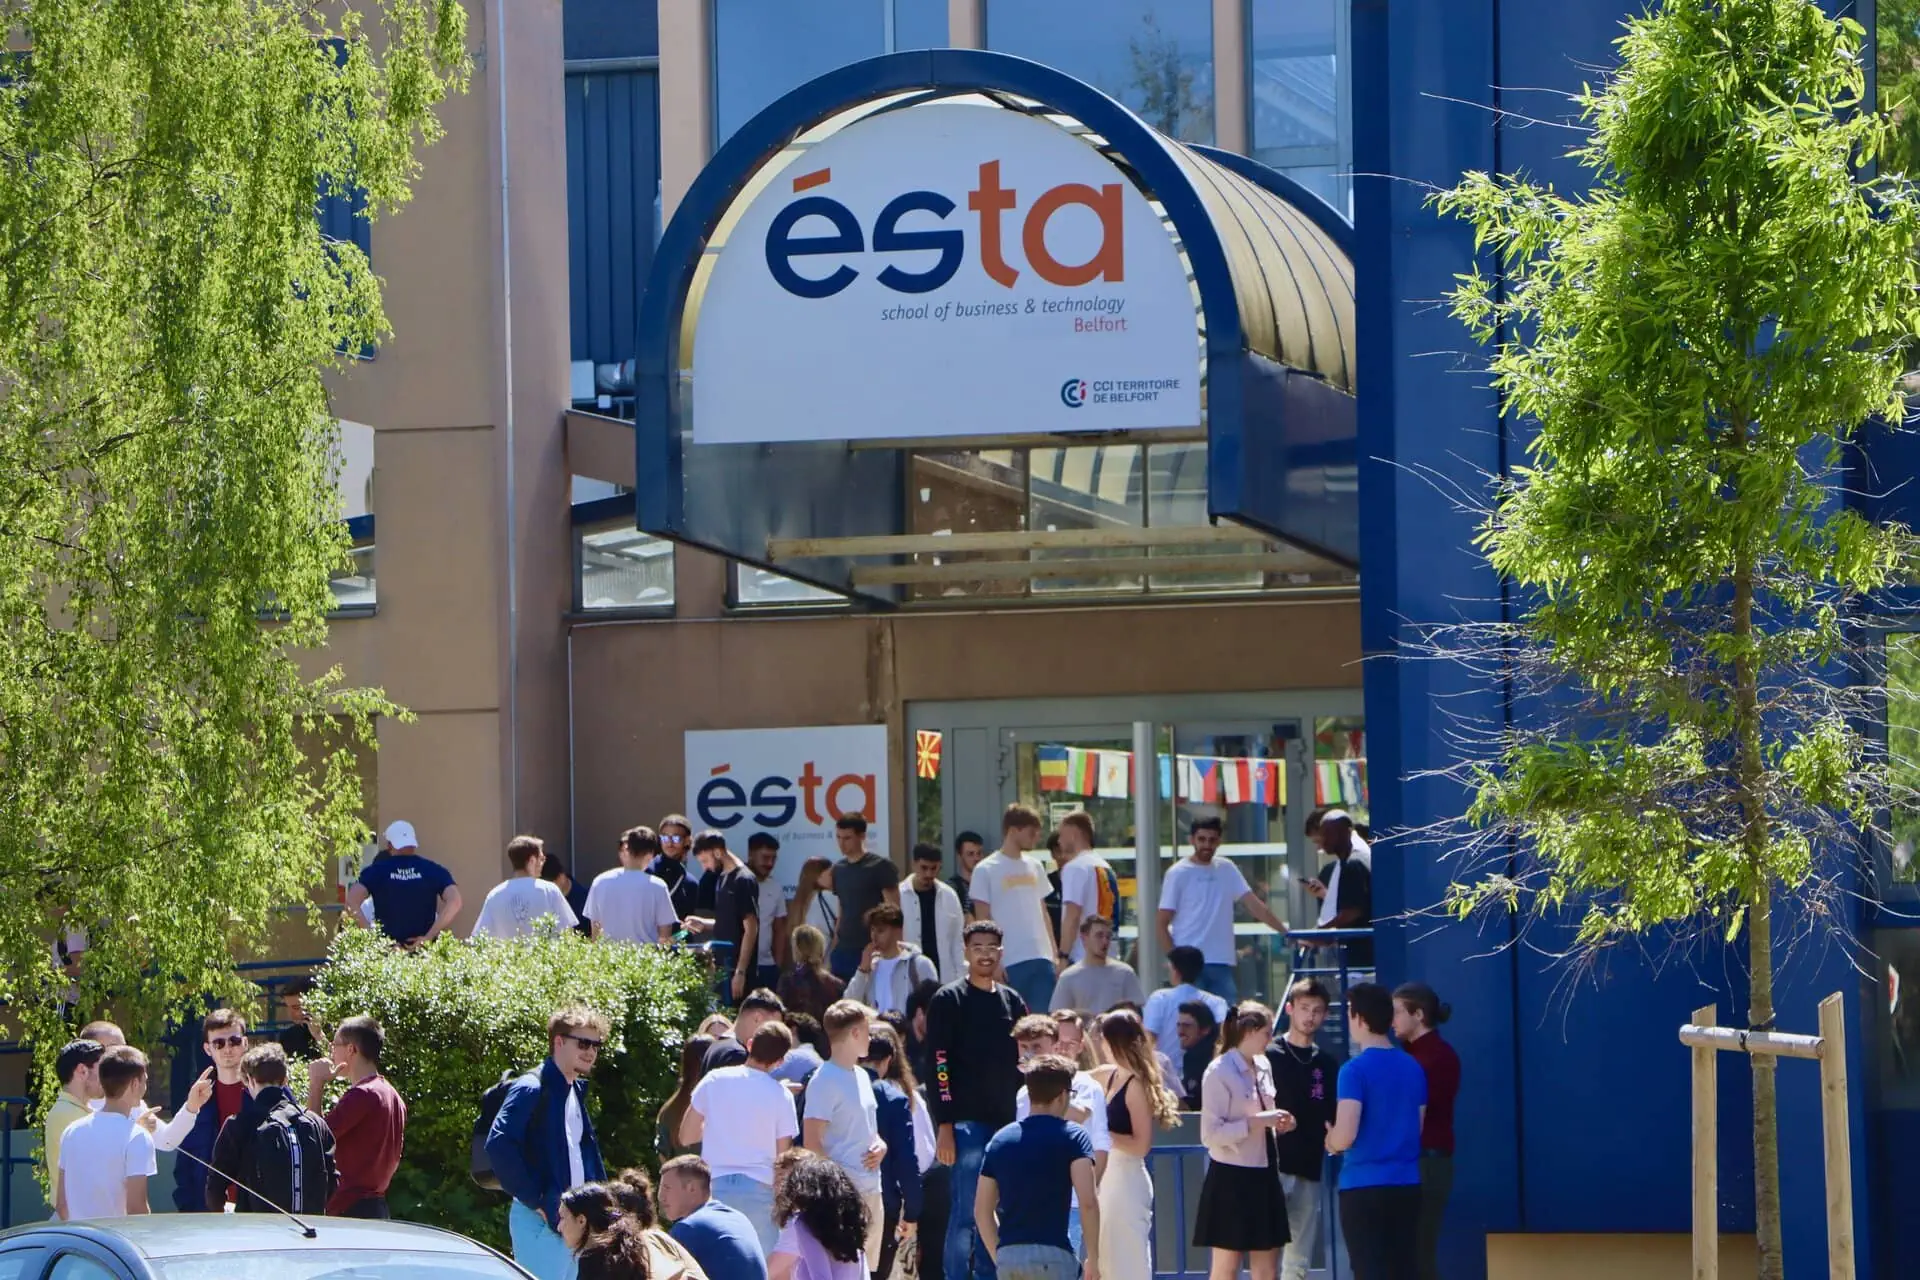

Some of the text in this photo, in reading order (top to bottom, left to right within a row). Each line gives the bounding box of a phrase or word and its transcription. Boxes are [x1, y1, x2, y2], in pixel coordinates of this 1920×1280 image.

[765, 160, 1124, 299] ésta
[881, 295, 1125, 321] school of business & technology
[1074, 316, 1128, 333] Belfort
[1093, 379, 1181, 392] CCI TERRITOIRE
[1093, 391, 1160, 403] DE BELFORT
[697, 760, 876, 829] ésta
[390, 872, 422, 880] RWANDA
[397, 867, 416, 875] VISIT
[936, 1050, 952, 1101] LACOSTE
